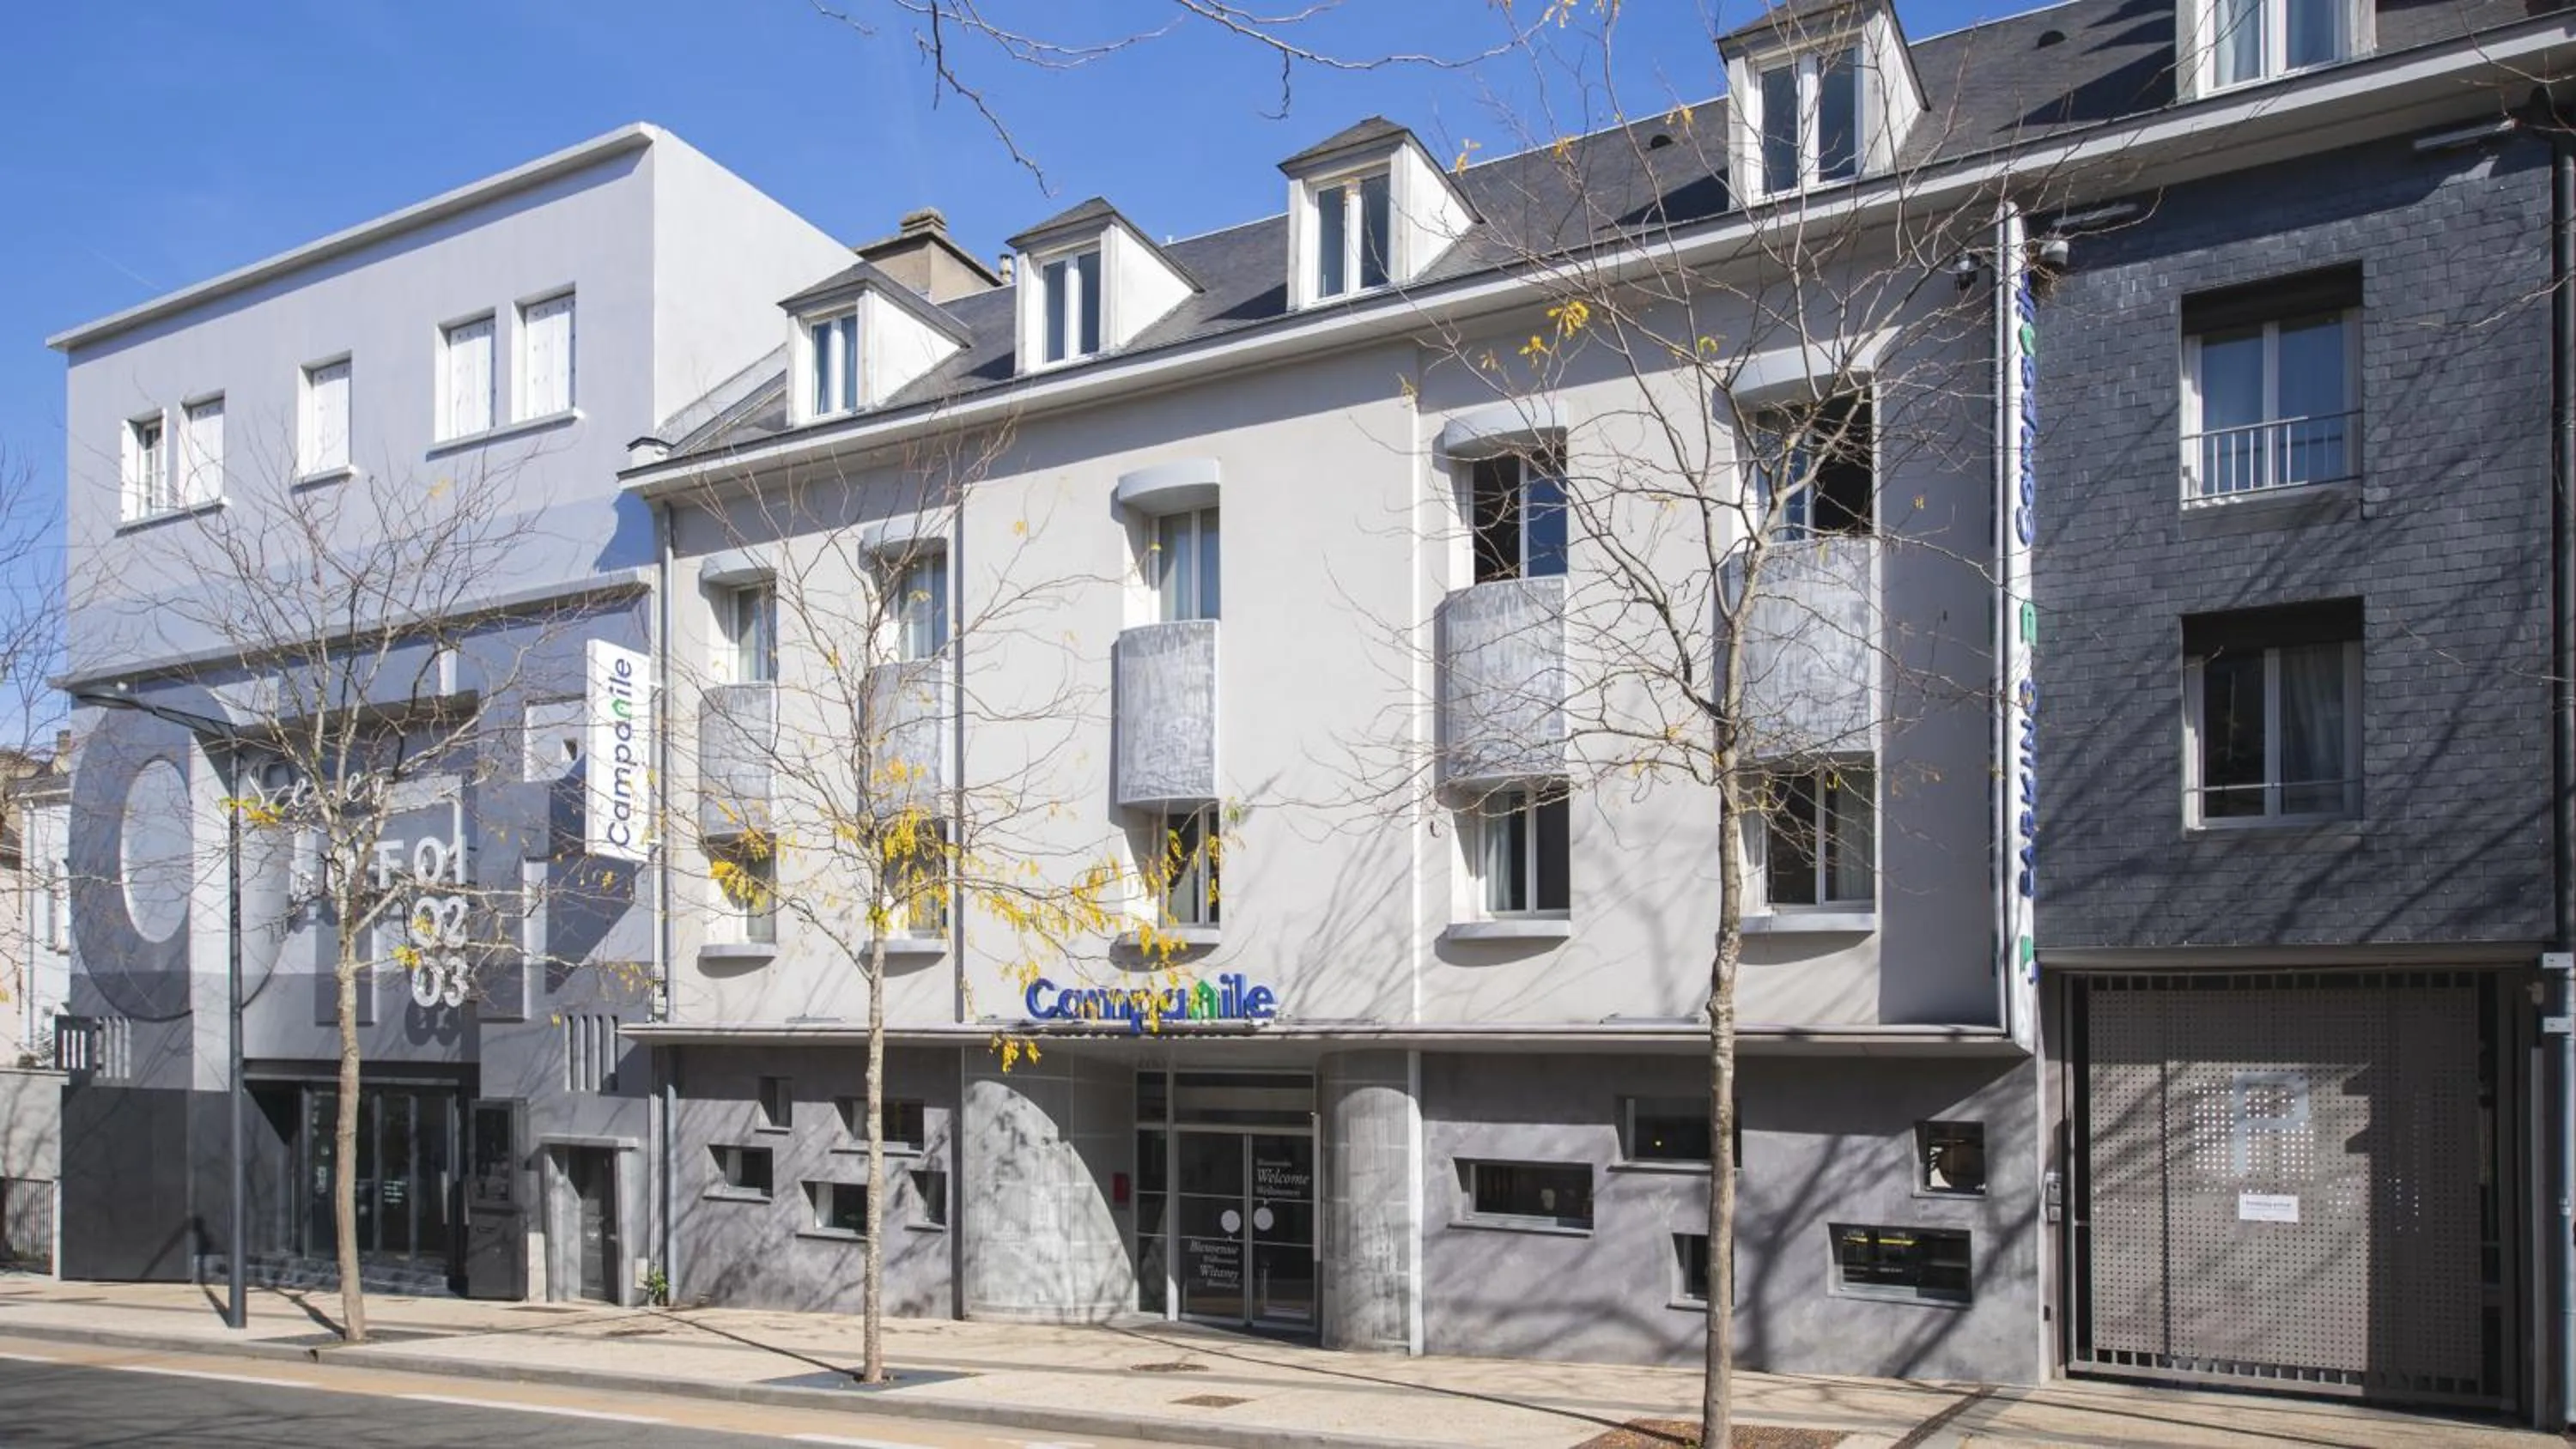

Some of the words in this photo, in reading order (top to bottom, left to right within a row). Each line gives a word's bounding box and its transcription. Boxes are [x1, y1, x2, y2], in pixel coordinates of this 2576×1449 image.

[607, 657, 638, 848] Campanile
[2019, 676, 2037, 896] PARKING
[413, 835, 467, 887] 01
[411, 895, 468, 949] 02
[411, 955, 469, 1008] 03
[1026, 973, 1278, 1034] Campanile
[2233, 1072, 2310, 1174] P
[1257, 1167, 1310, 1186] Welcome
